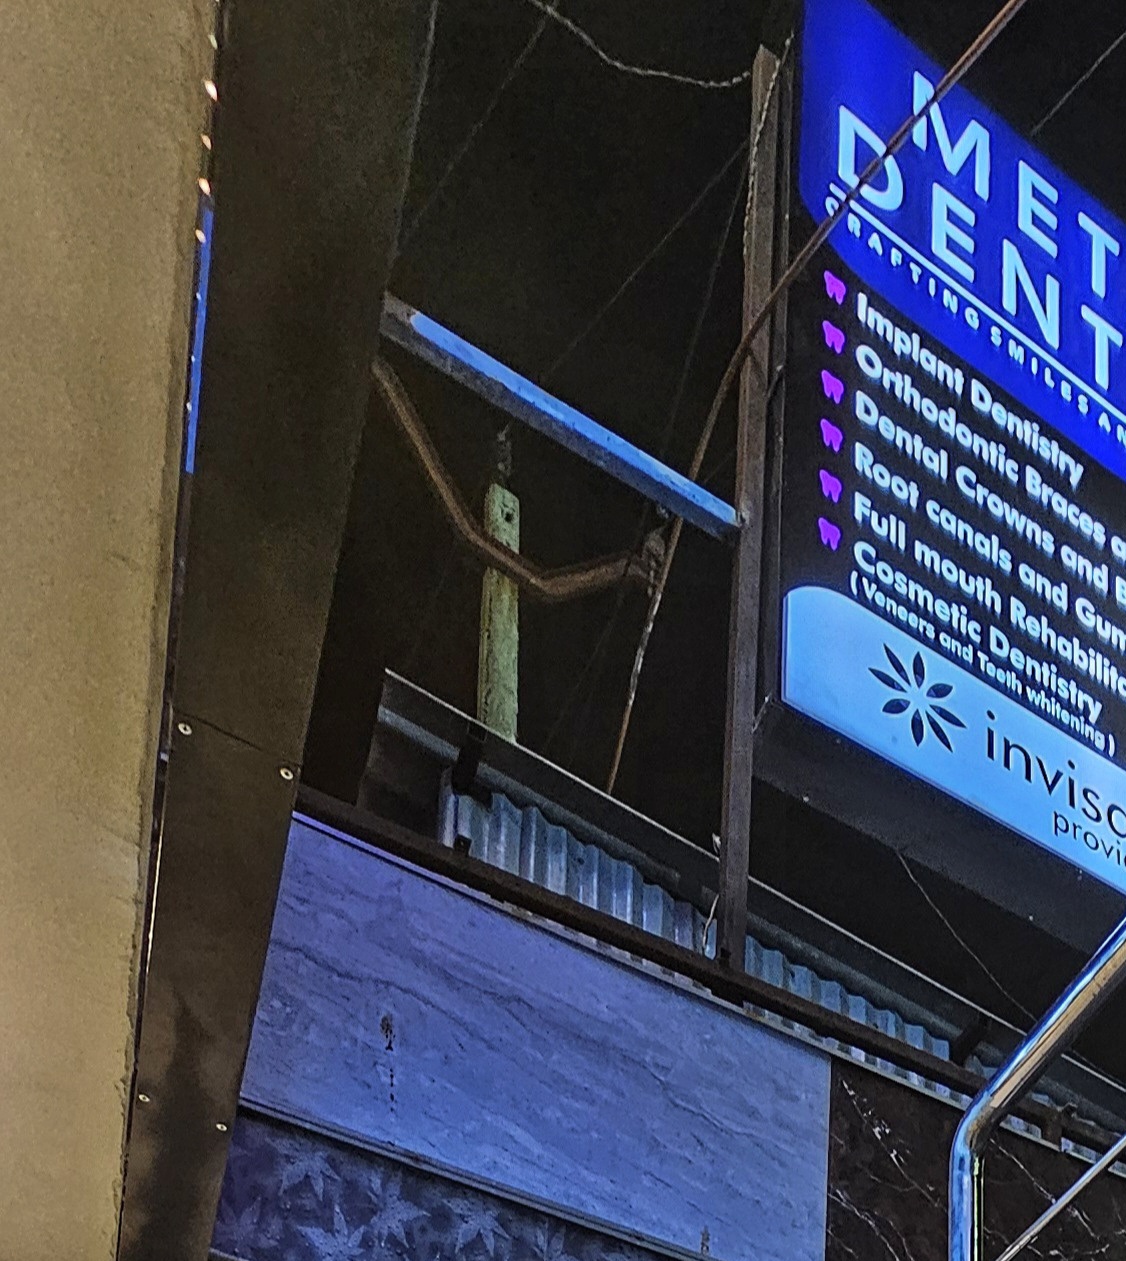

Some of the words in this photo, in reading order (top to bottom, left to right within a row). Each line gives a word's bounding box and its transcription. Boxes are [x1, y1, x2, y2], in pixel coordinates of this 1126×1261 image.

[825, 196, 980, 331] CRAFTING
[990, 325, 1089, 415] SMILES
[857, 291, 965, 397] Implant
[970, 378, 1084, 488] Dentistry
[855, 344, 1019, 483] Orthodontic
[1025, 464, 1106, 544] Braces
[855, 390, 949, 480] Dental
[955, 465, 1055, 555] Crowns
[1060, 545, 1108, 594] and
[855, 441, 920, 509] Root
[926, 499, 1013, 573] canals
[1018, 563, 1068, 613] and
[853, 541, 982, 644] Cosmetic
[989, 624, 1103, 724] Dentistry
[854, 491, 906, 551] Full
[914, 539, 1002, 615] mouth
[939, 632, 973, 663] and
[977, 650, 1023, 694] Teeth
